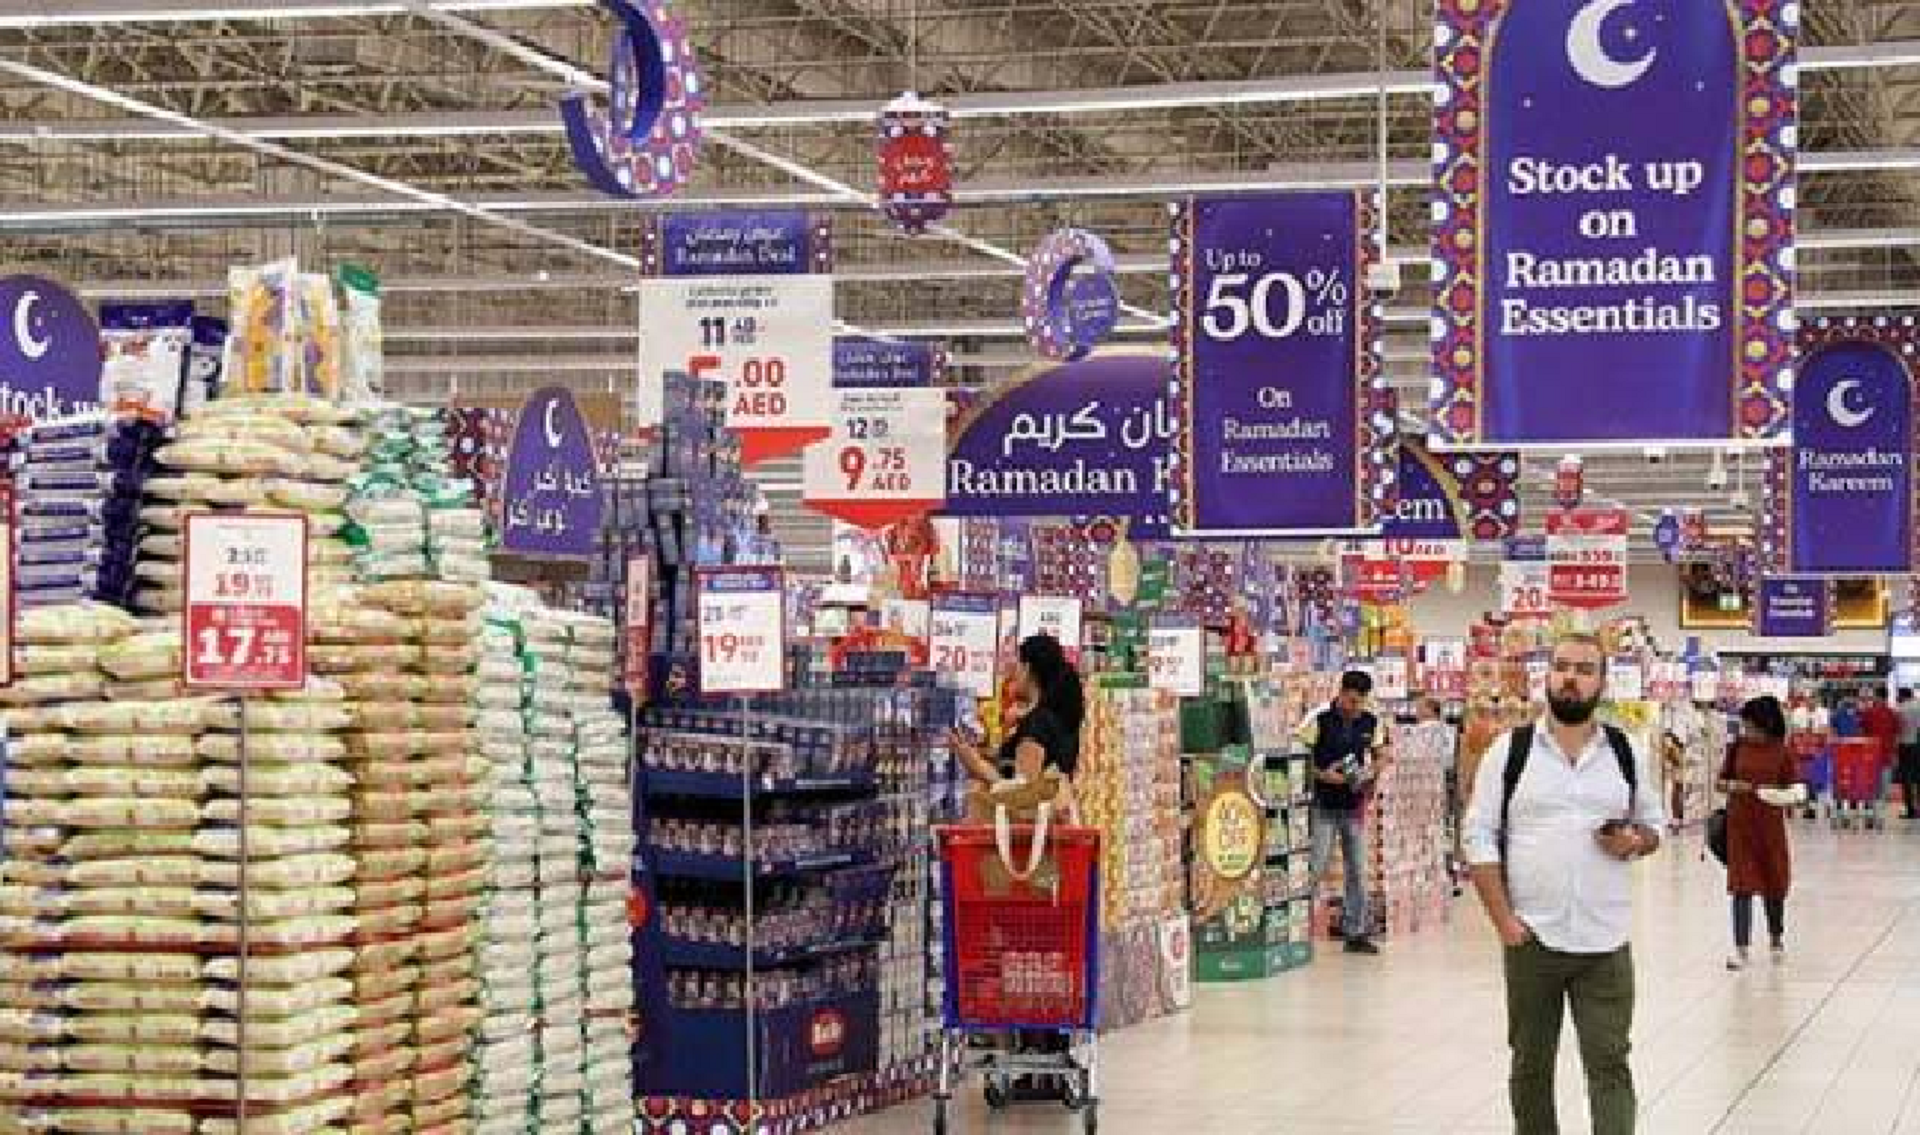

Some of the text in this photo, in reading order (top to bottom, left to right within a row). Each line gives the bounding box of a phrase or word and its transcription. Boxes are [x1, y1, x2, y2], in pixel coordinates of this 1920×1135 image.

[1508, 155, 1702, 195] Stock up
[1579, 210, 1637, 239] on
[1205, 248, 1262, 273] Up to
[1506, 247, 1715, 288] Ramadan
[1307, 308, 1346, 336] off
[1500, 295, 1721, 336] Essentials
[732, 392, 788, 417] AED
[1257, 386, 1293, 409] On
[1004, 400, 1106, 457] كريم
[1222, 415, 1331, 441] Ramadan
[1221, 447, 1334, 474] Essentials
[1799, 447, 1903, 468] Ramadan
[951, 458, 1138, 495] Ramadan
[1808, 472, 1894, 492] Kareem
